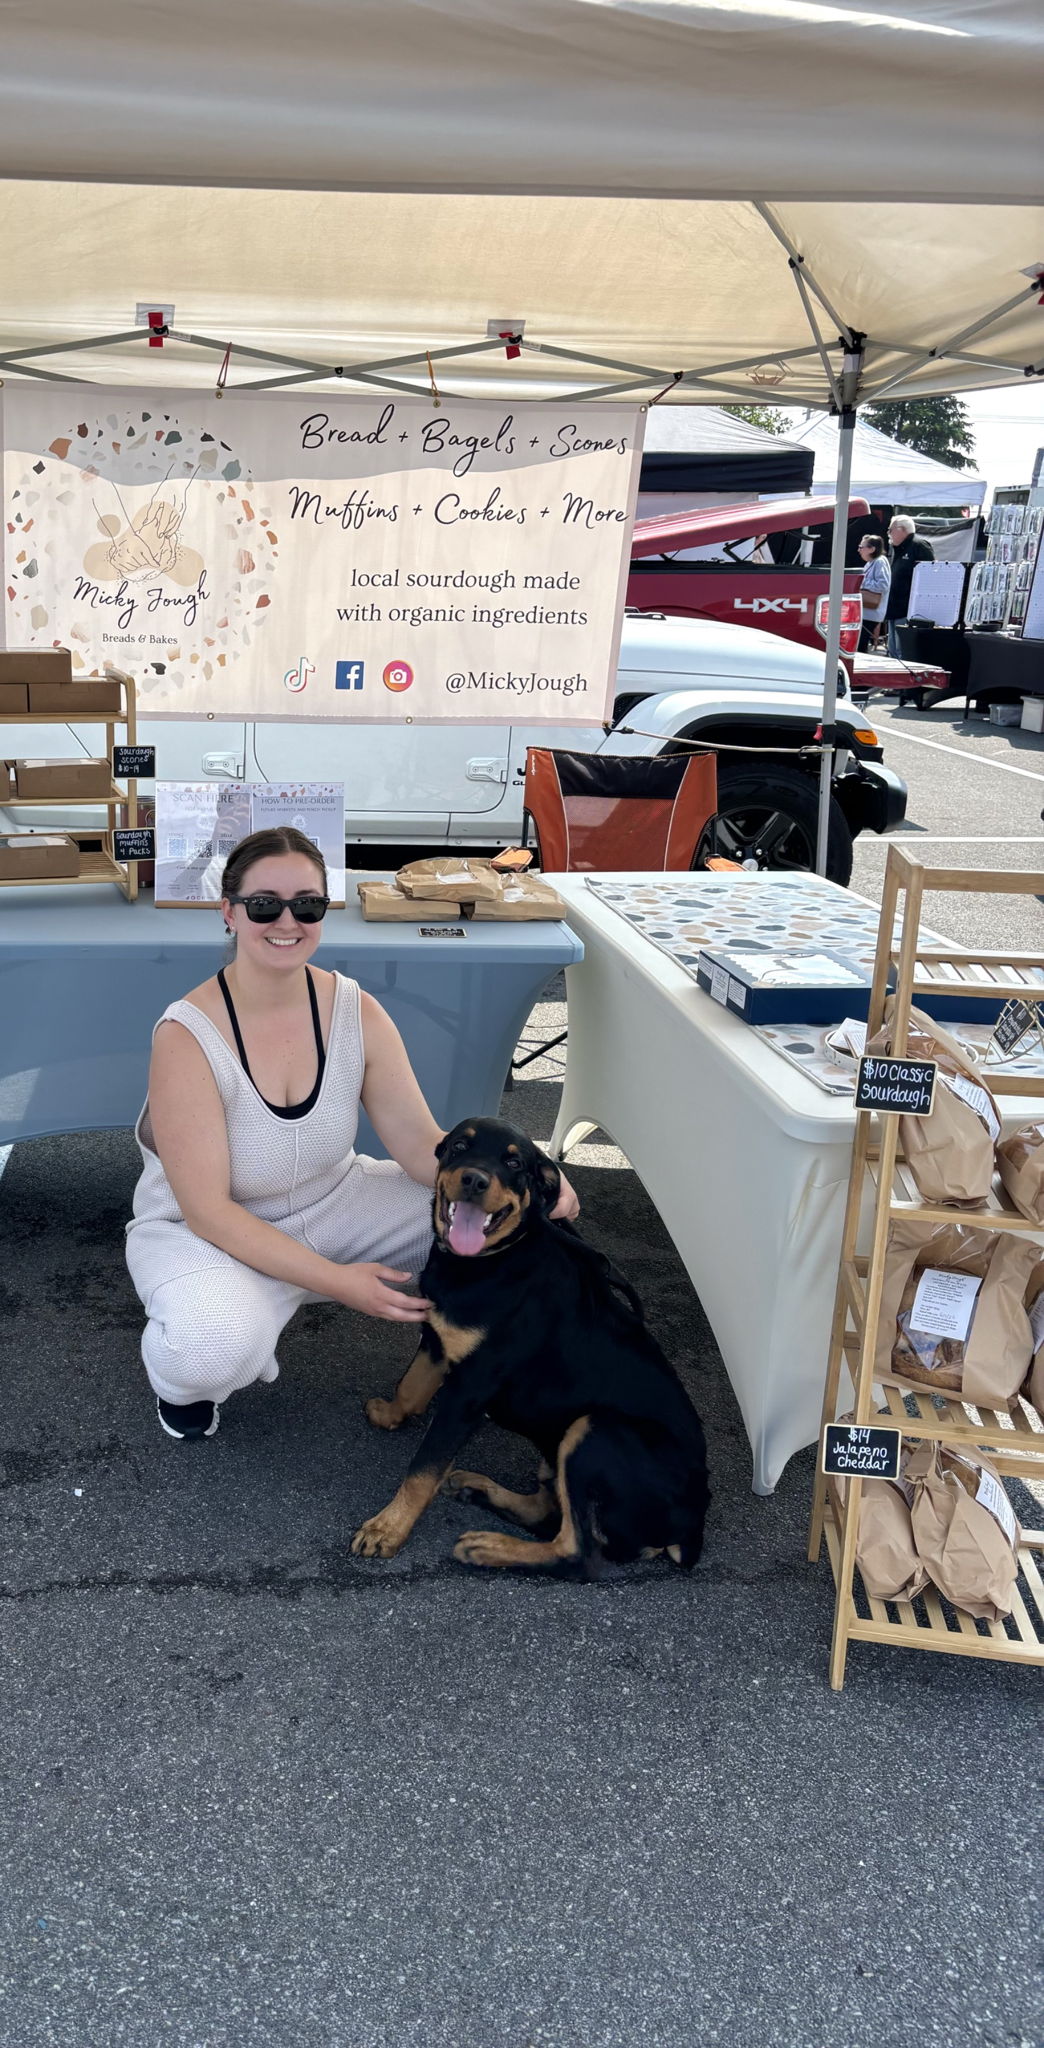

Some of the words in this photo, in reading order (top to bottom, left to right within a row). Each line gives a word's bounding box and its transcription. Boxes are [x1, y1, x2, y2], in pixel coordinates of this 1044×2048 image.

[300, 403, 395, 449] Bread
[421, 414, 515, 478] Bagels
[550, 424, 628, 457] Scones
[288, 486, 400, 530] Muffins
[434, 487, 527, 525] Cookies
[562, 492, 630, 529] More
[350, 569, 400, 587] local
[406, 570, 516, 593] sourdough
[522, 571, 581, 590] made
[73, 576, 139, 629] Micky
[147, 569, 211, 627] Jough
[336, 604, 381, 622] with
[388, 604, 466, 627] organic
[471, 605, 588, 628] ingredients
[102, 633, 136, 643] Breads
[137, 634, 146, 643] &
[149, 634, 178, 645] Bakes
[445, 671, 588, 696] @MickyJough
[173, 794, 203, 803] SCAN
[207, 795, 234, 803] HERE
[863, 1058, 888, 1080] $10
[889, 1064, 933, 1083] Classic
[848, 1427, 871, 1444] $14
[833, 1442, 887, 1459] Jalapeno
[837, 1454, 889, 1470] Cheddar
